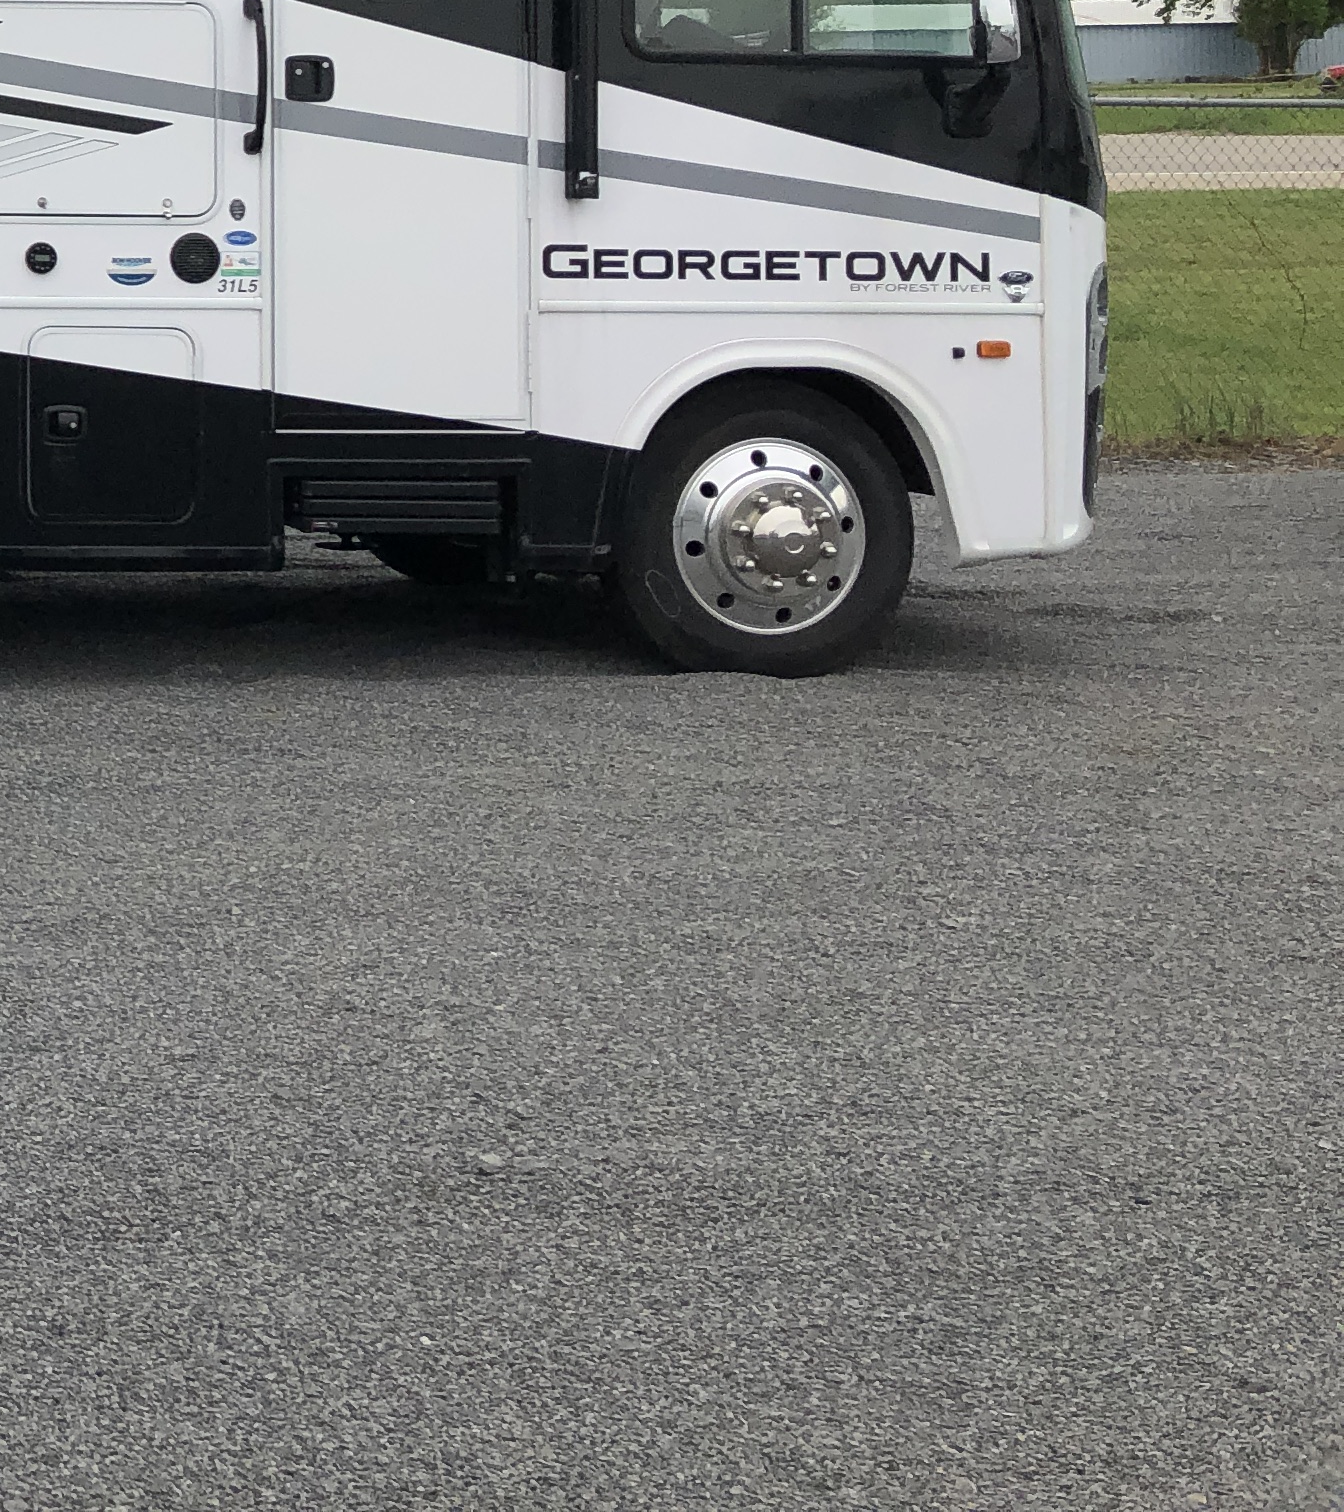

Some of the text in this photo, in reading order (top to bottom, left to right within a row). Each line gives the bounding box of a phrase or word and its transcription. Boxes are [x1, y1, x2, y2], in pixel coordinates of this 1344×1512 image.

[542, 244, 990, 282] GEORGETOWN
[217, 279, 258, 293] 31L5
[850, 283, 992, 293] BY FOREST RIVER
